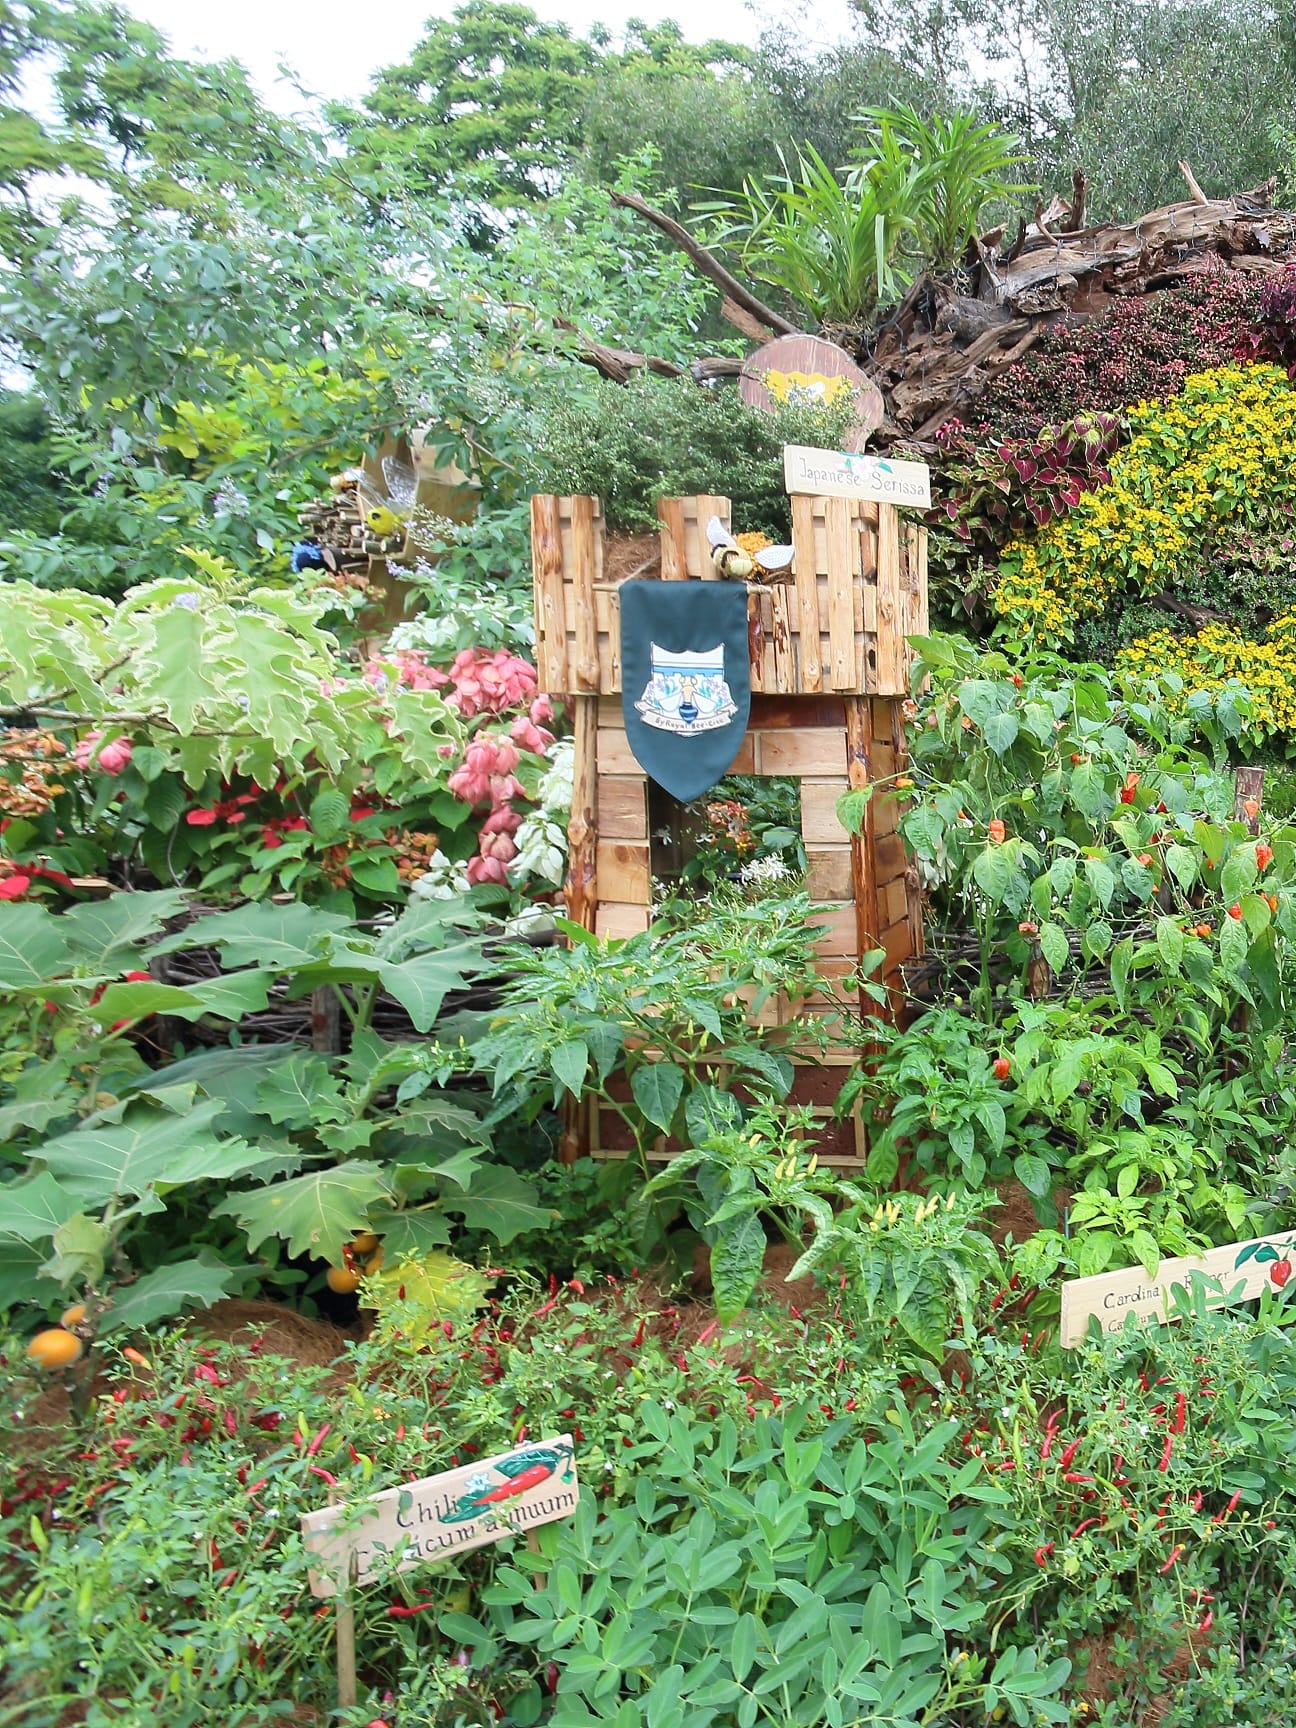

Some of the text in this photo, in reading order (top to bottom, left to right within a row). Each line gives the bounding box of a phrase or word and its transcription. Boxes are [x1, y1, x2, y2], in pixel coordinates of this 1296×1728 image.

[799, 457, 925, 496] Japanese Serissa
[1104, 1285, 1160, 1309] Carolina
